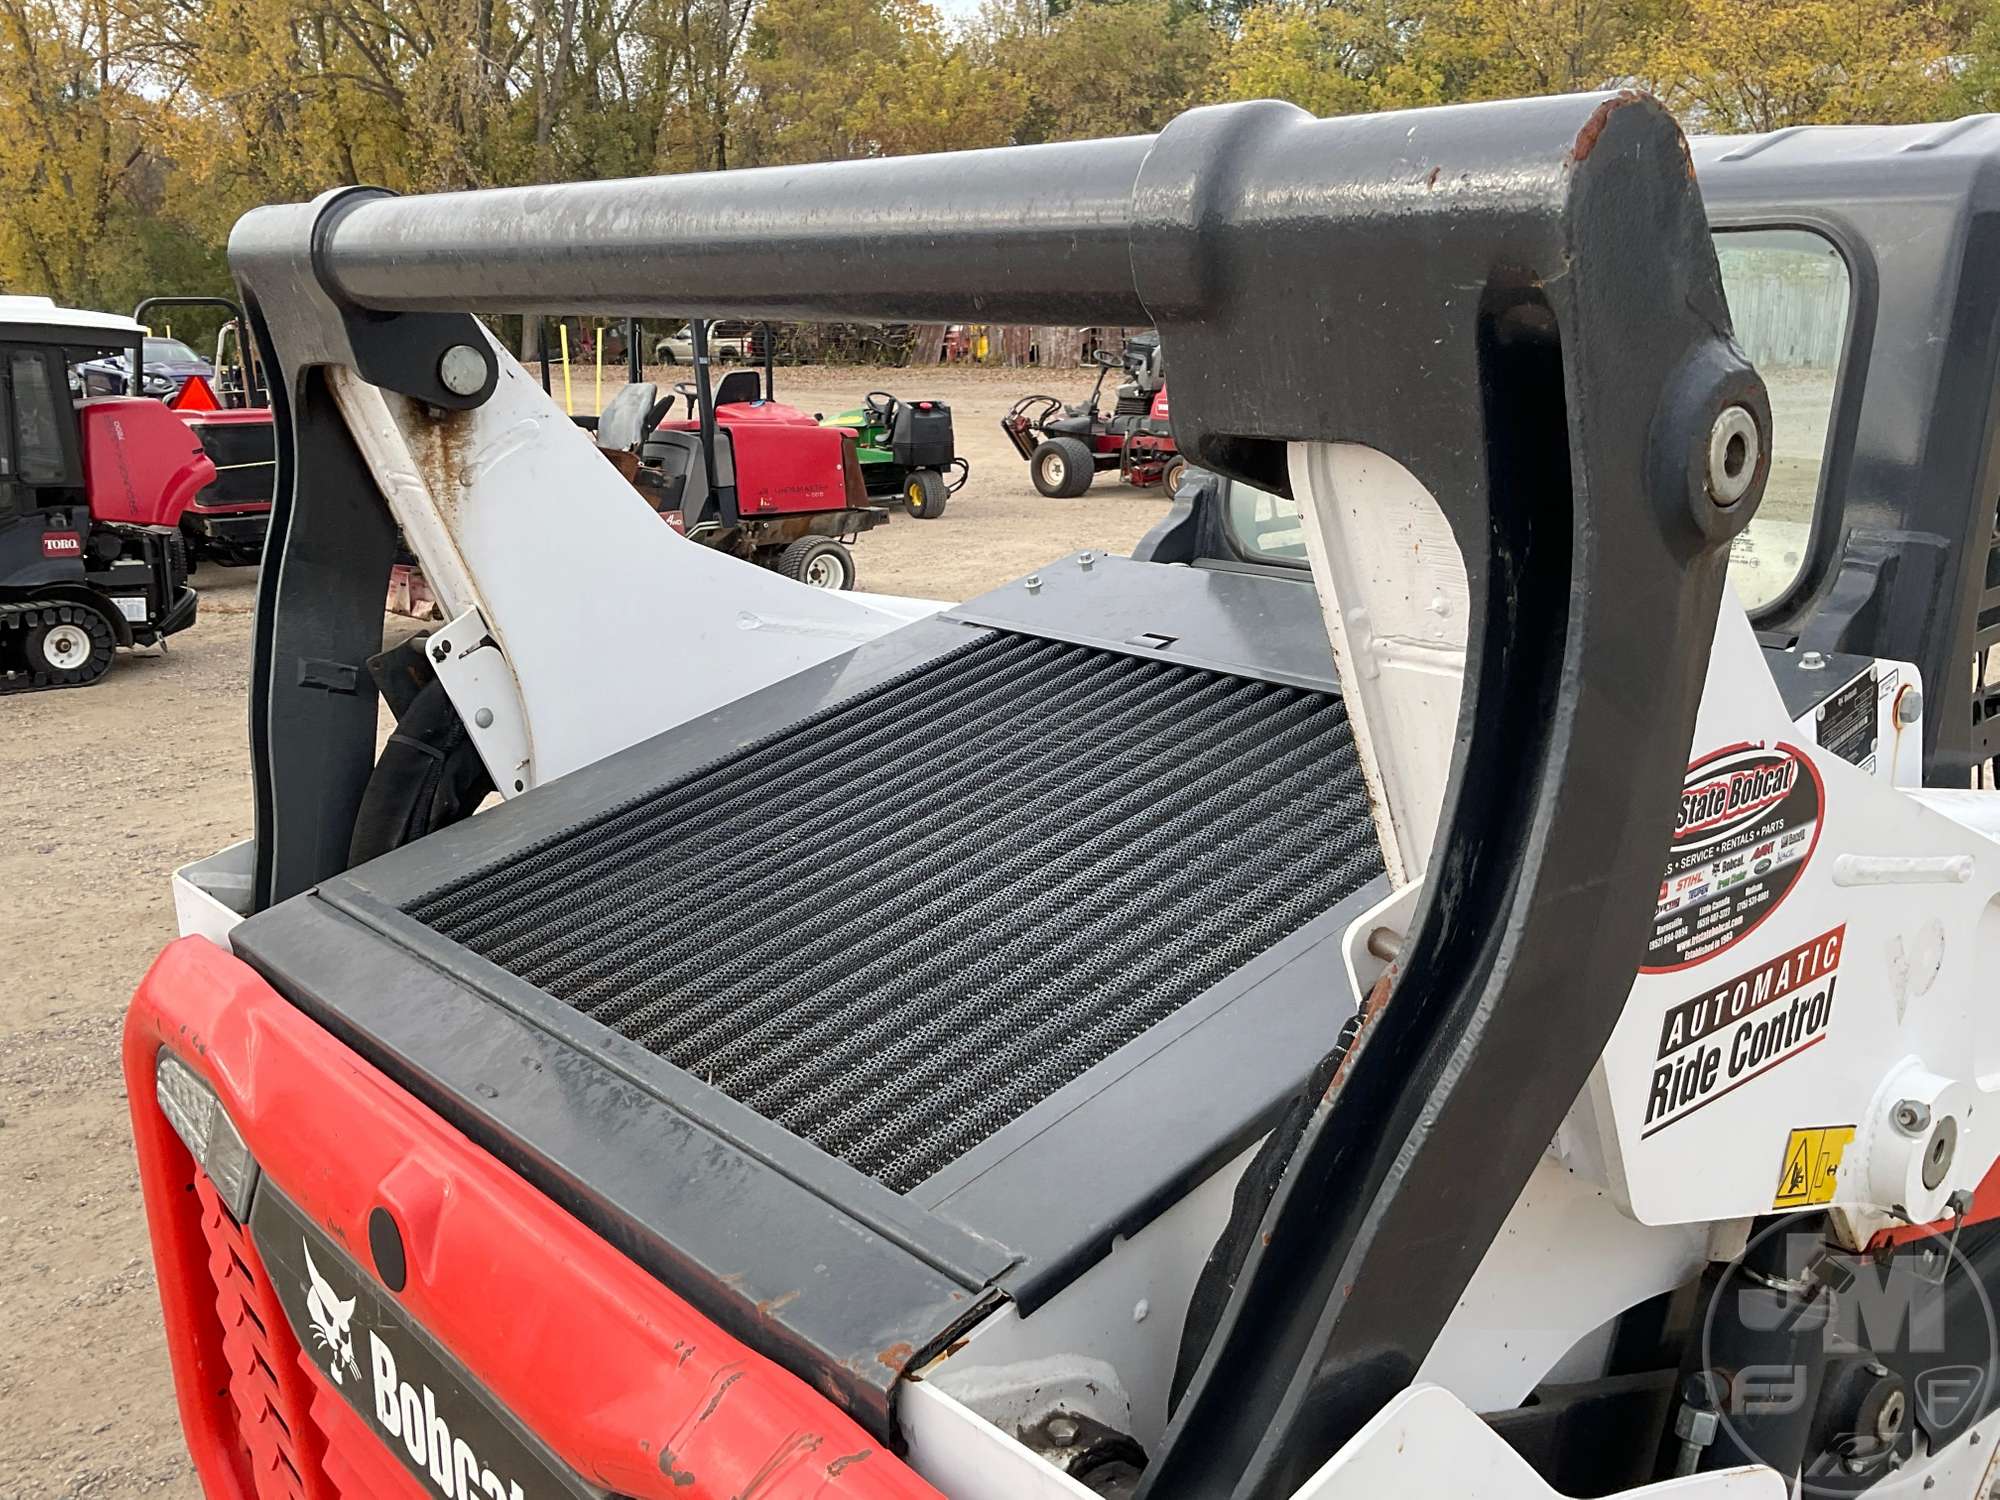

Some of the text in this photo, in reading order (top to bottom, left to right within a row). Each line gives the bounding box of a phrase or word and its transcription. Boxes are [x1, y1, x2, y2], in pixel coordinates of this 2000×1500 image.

[1677, 760, 1791, 829] State Bobcat
[1676, 872, 1703, 891] STIHL
[1680, 847, 1714, 869] SERVICE
[1721, 831, 1754, 853] RENTALS
[1761, 819, 1784, 837] PARTS
[1665, 936, 1838, 1051] AUTOMATIC
[1644, 975, 1837, 1125] Ride Control
[369, 1329, 525, 1500] Bobc
